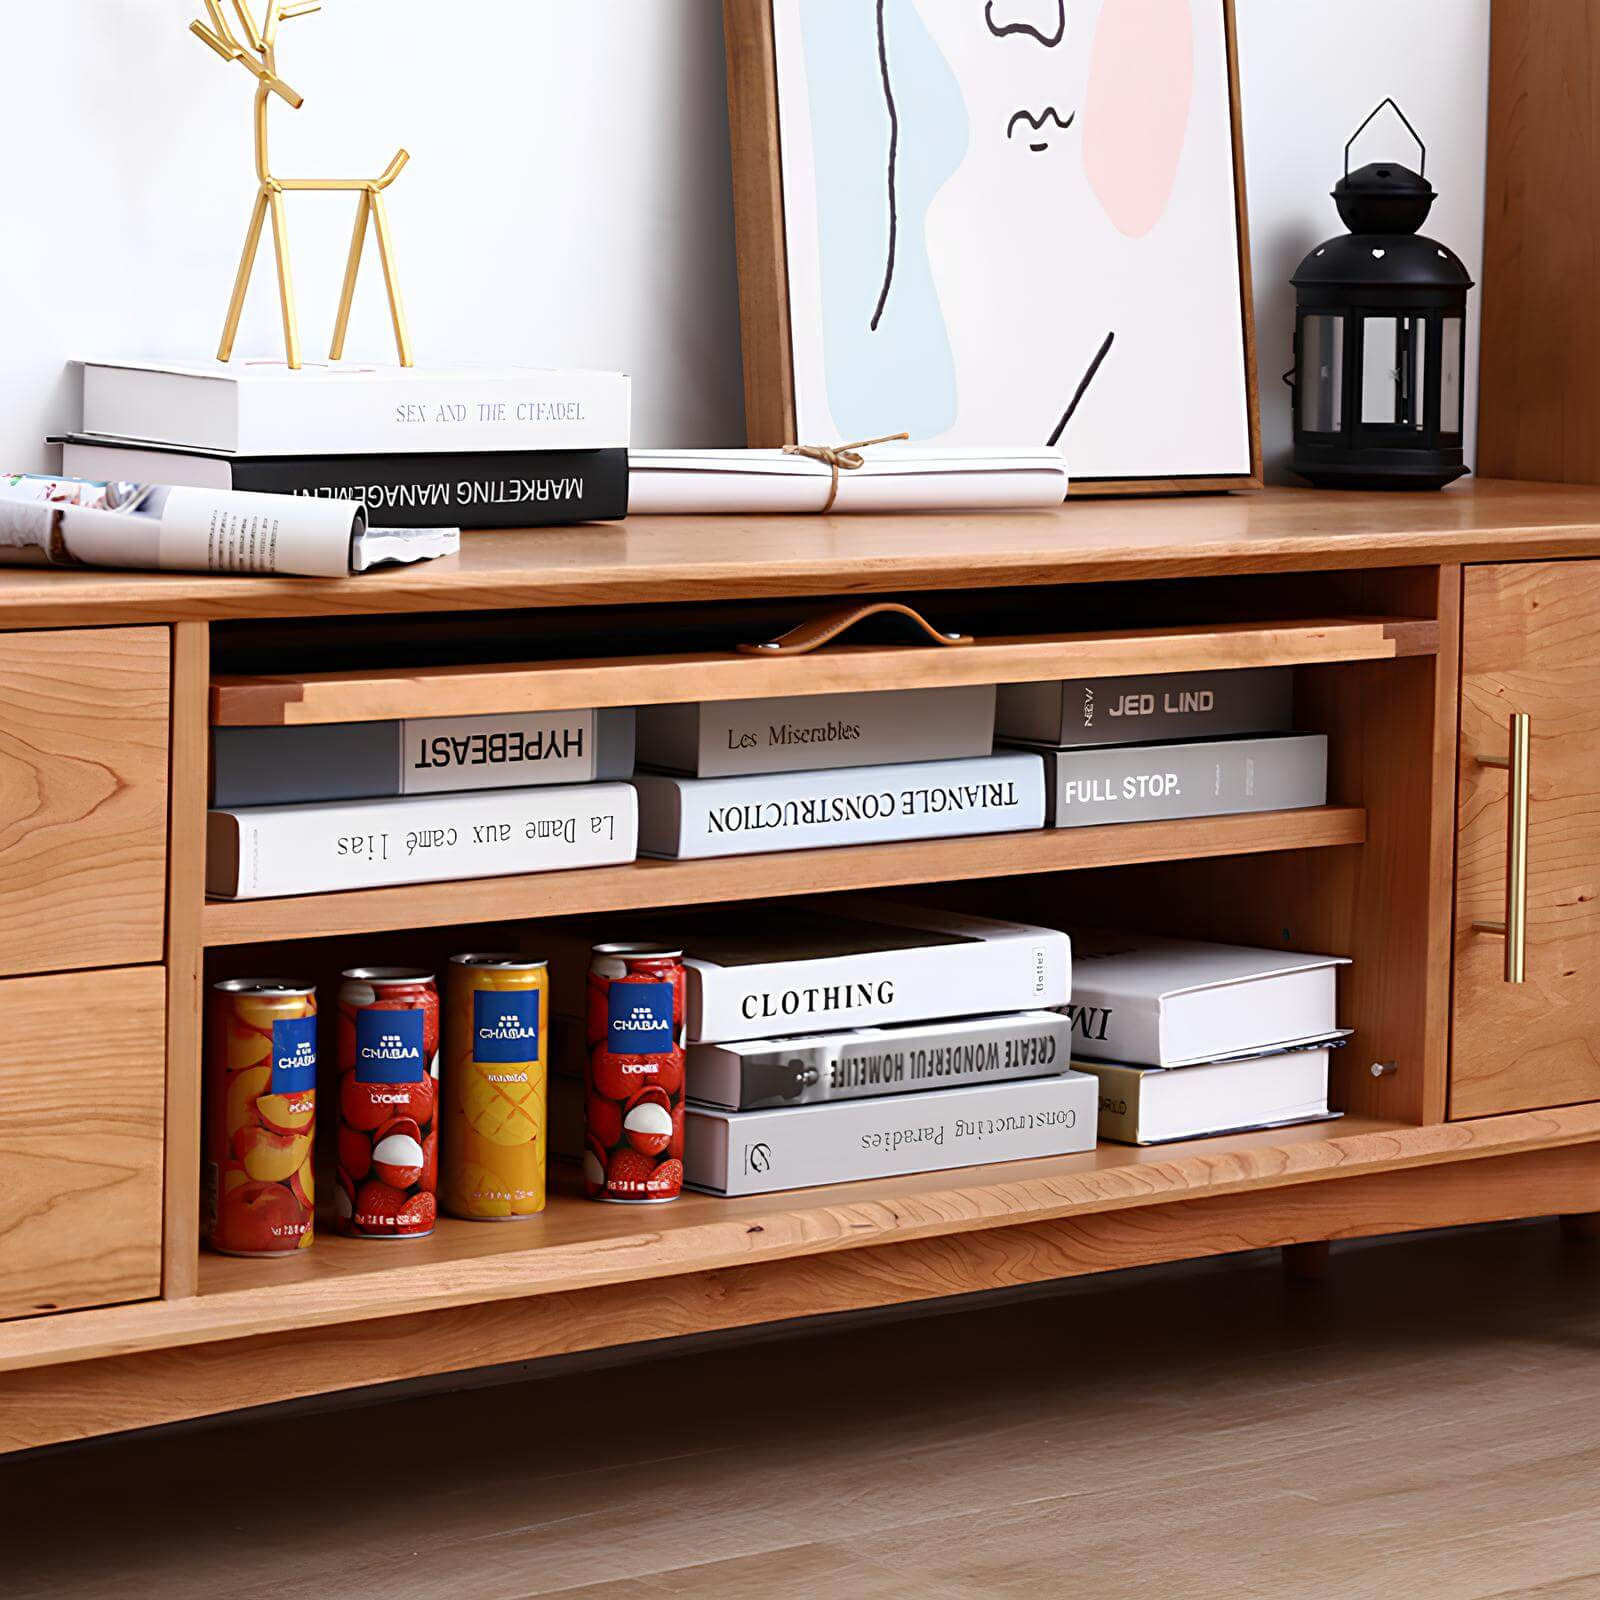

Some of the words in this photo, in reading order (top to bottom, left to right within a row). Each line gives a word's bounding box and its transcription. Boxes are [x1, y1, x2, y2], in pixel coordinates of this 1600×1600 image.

[435, 404, 467, 423] AND
[476, 403, 507, 422] THE
[293, 483, 450, 508] MANAGEM
[456, 477, 584, 505] MARKETING
[1108, 694, 1155, 717] JED
[1164, 690, 1215, 714] LIND
[414, 728, 584, 769] HYPEBEAST
[727, 728, 759, 750] Les
[767, 720, 861, 746] Miserables
[902, 781, 1019, 816] TRIANGLE
[1065, 778, 1118, 804] FULL
[1122, 772, 1181, 800] STOP.
[589, 814, 615, 841] La
[707, 793, 896, 834] CONSTRUCTION
[406, 826, 458, 856] camé
[472, 822, 511, 844] aux
[525, 817, 576, 844] Dame
[336, 833, 389, 861] lias
[741, 980, 896, 1020] CLOTHING
[909, 1042, 1002, 1081] WONDERFUL
[1004, 1035, 1057, 1068] CREATE
[829, 1053, 905, 1090] HOMELIFE
[860, 1124, 945, 1152] Paradies
[954, 1108, 1077, 1141] Constructing
